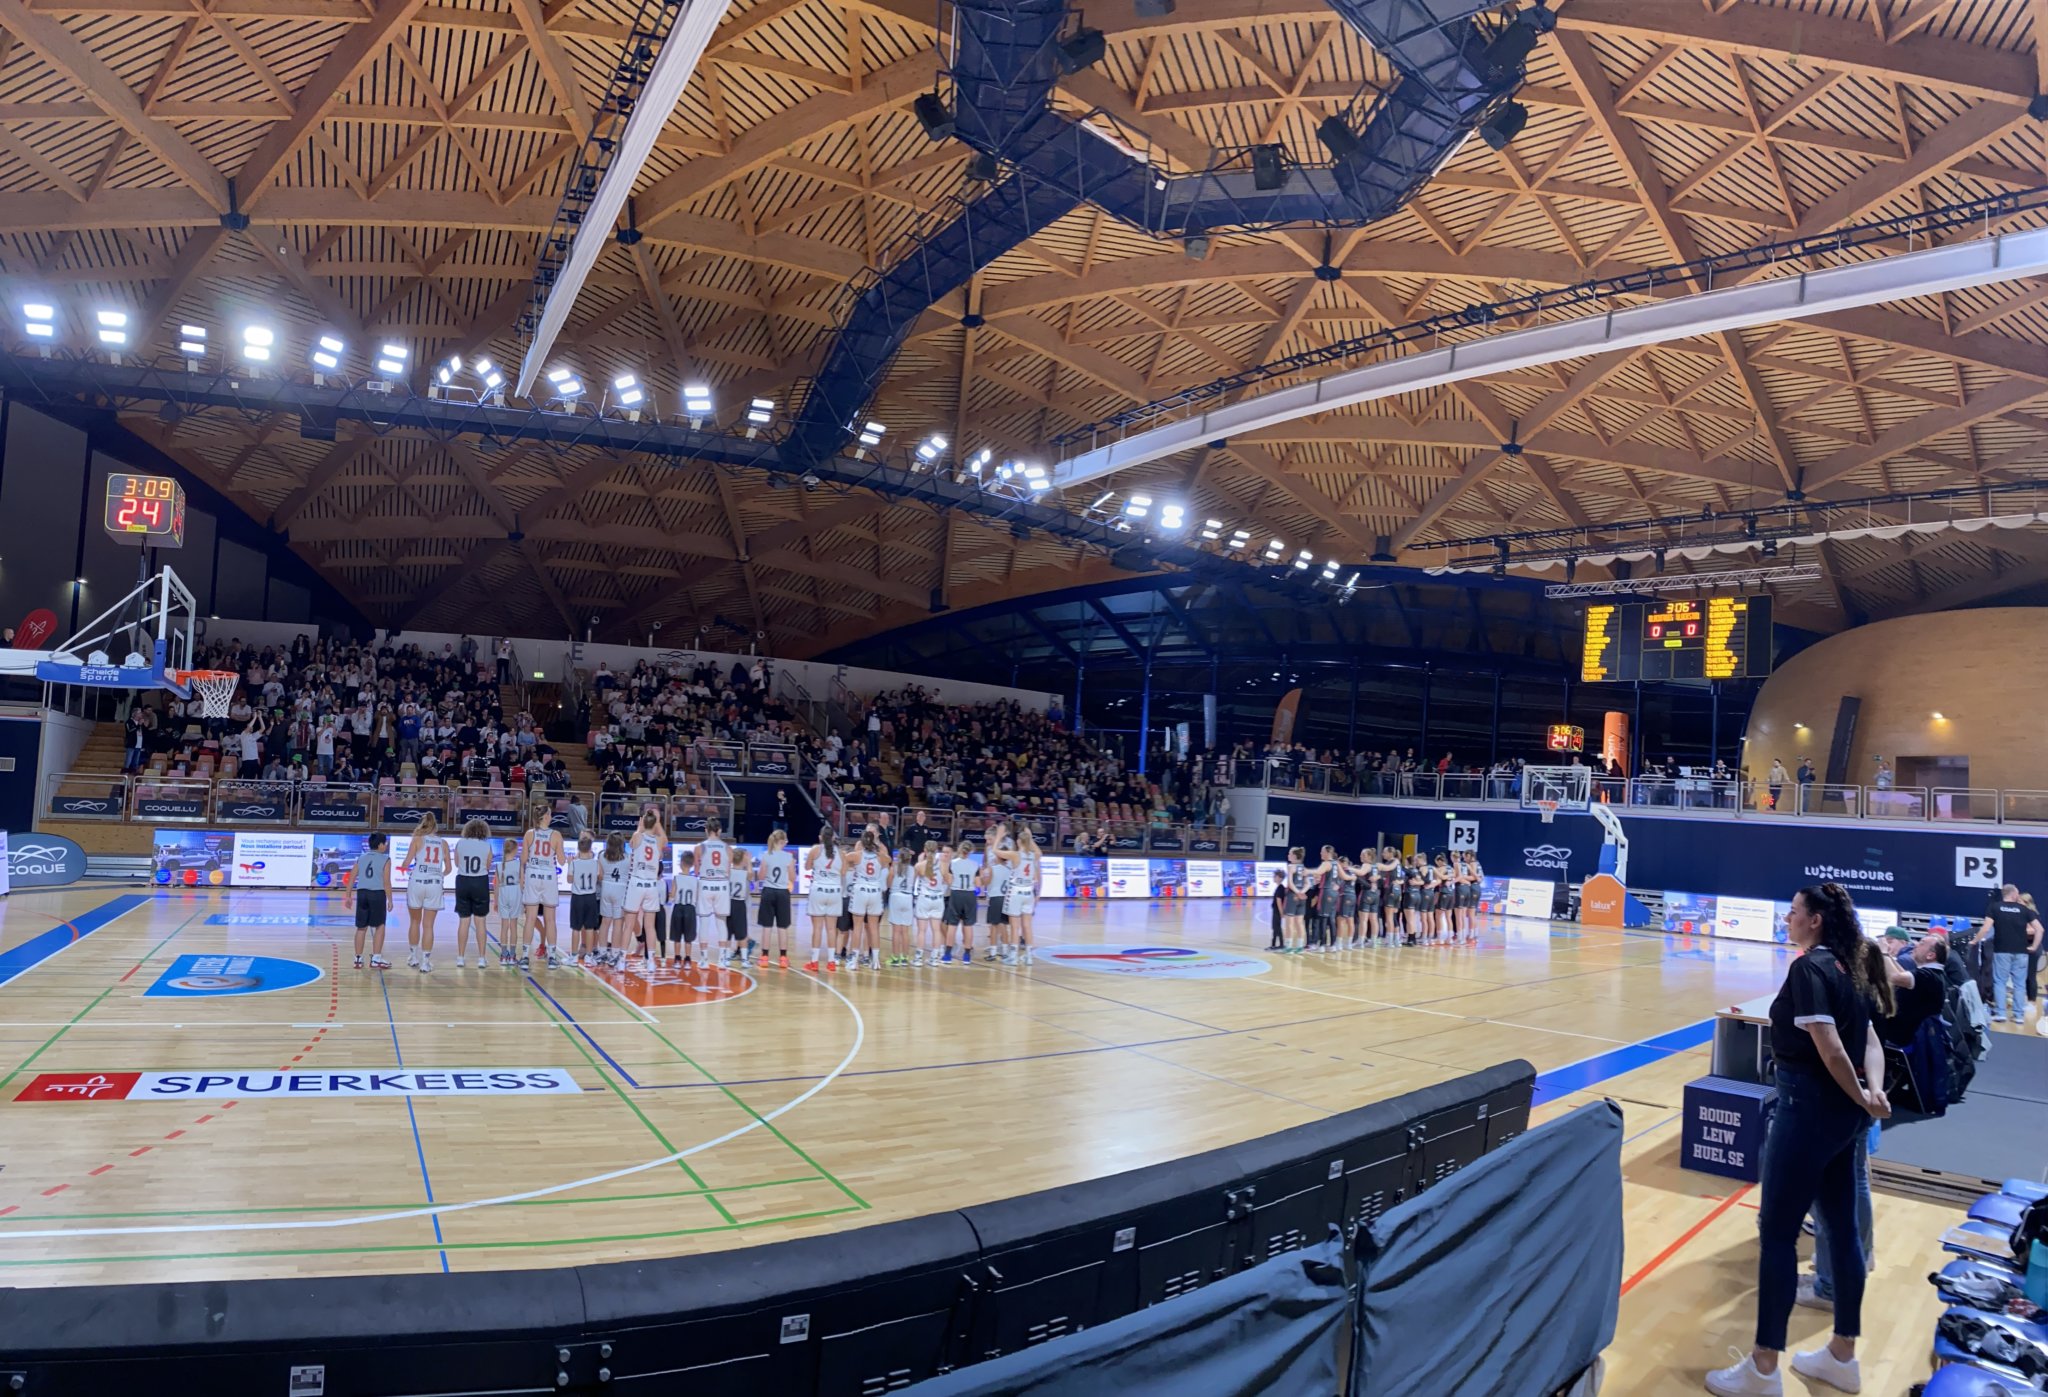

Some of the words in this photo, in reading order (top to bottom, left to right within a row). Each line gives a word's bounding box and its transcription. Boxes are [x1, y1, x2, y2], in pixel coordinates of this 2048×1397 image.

[125, 479, 170, 497] 3:09
[118, 499, 159, 525] 24
[1652, 626, 1661, 637] 0
[1687, 624, 1696, 635] 0
[571, 642, 584, 661] E
[80, 673, 119, 682] Sports
[1551, 735, 1568, 747] 24
[144, 804, 196, 813] COQUE.LU
[310, 809, 360, 817] COQUE.LU
[466, 814, 512, 822] COQUE.LU
[1272, 822, 1286, 839] P1
[1454, 826, 1475, 845] P3
[424, 846, 440, 864] 11
[534, 839, 552, 857] 10
[644, 846, 654, 862] 9
[463, 855, 481, 873] 10
[711, 850, 721, 867] 8
[1525, 858, 1569, 869] COQUE
[8, 863, 66, 876] COQUE
[365, 860, 374, 878] 6
[611, 867, 620, 882] 4
[772, 866, 782, 884] 9
[866, 862, 875, 876] 6
[1023, 863, 1030, 877] 4
[1964, 856, 1998, 879] P3
[580, 873, 593, 890] 11
[959, 874, 970, 889] 11
[1000, 879, 1008, 895] 6
[678, 889, 693, 904] 10
[151, 1073, 560, 1093] SPUERKEESS
[1699, 1105, 1742, 1127] ROUDE
[1703, 1126, 1736, 1146] LEIW
[1693, 1143, 1726, 1164] HUEL
[1727, 1153, 1745, 1168] SE
